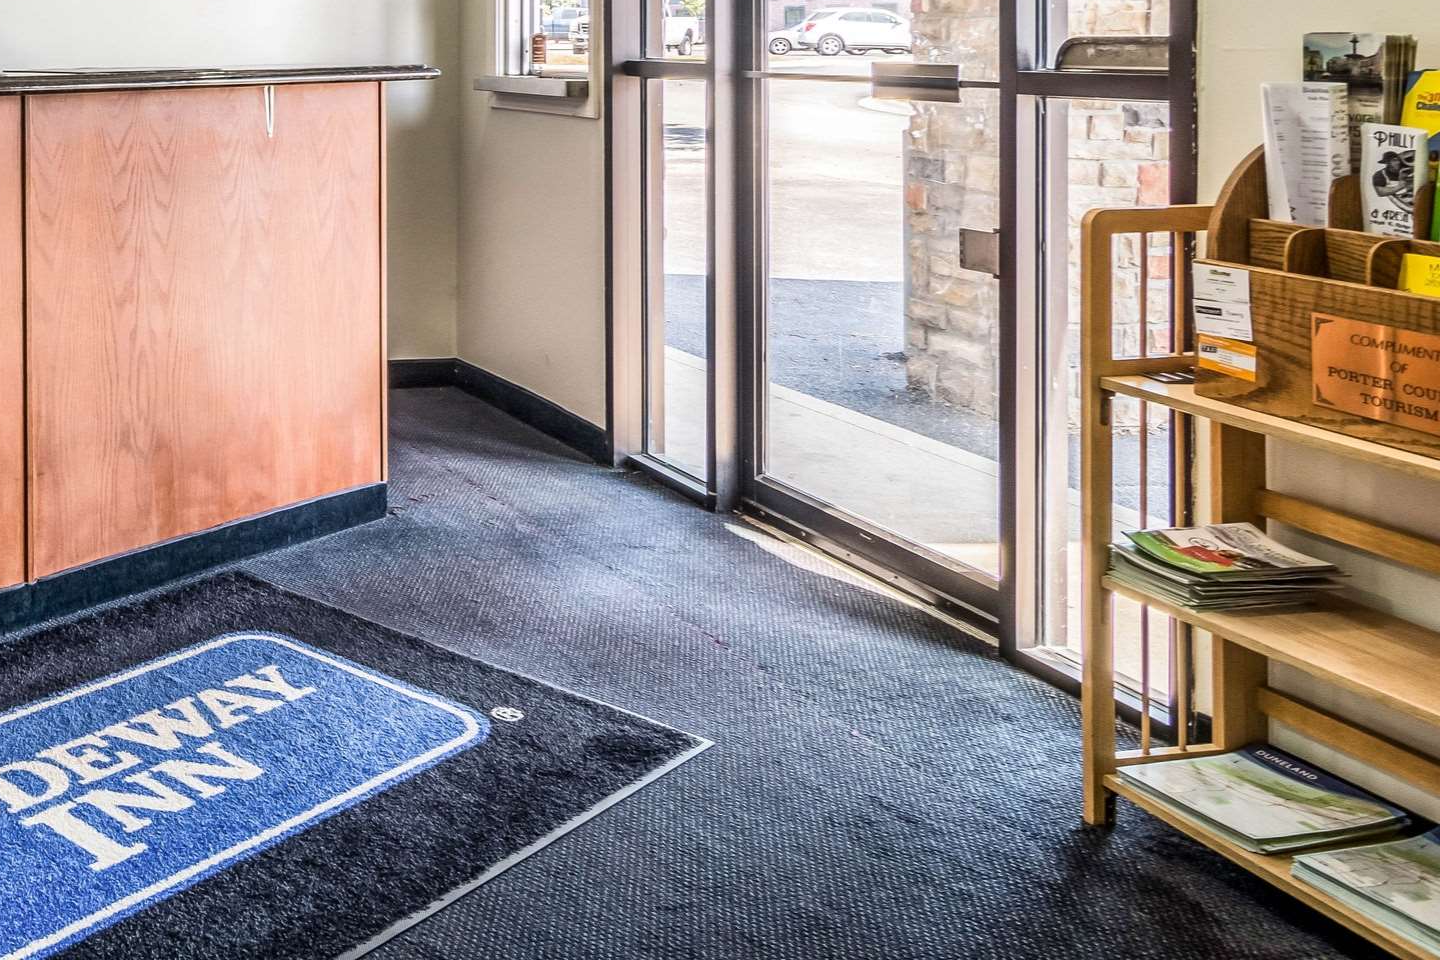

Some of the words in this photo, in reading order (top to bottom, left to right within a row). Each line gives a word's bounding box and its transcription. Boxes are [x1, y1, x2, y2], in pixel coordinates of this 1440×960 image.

[1328, 366, 1395, 391] PORTER
[1402, 383, 1440, 402] COU
[1390, 361, 1409, 374] OF
[1360, 392, 1440, 421] TOURISM
[1255, 749, 1319, 782] DUNELAND
[20, 741, 264, 871] INN
